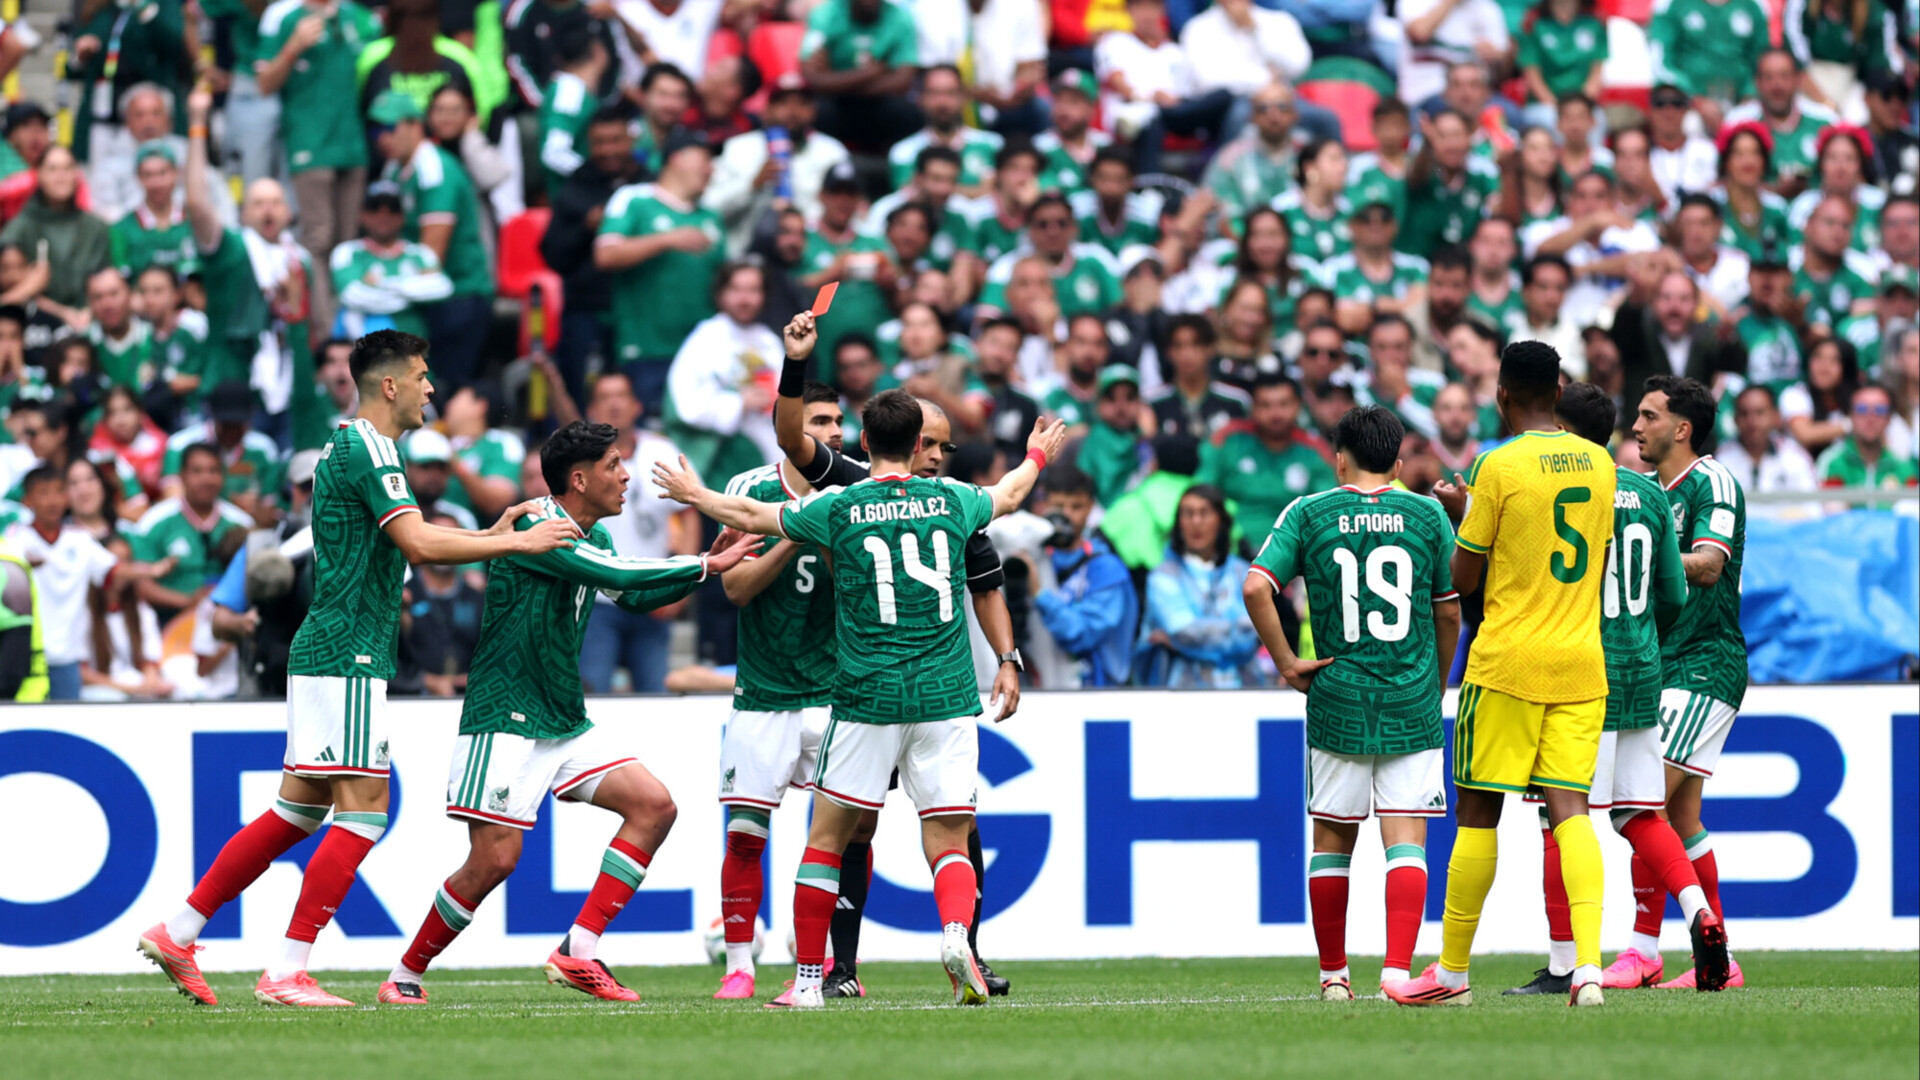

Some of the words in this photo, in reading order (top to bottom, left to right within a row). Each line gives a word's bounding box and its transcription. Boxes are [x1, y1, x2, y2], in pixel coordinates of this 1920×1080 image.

[1539, 452, 1593, 474] MBATHA
[849, 496, 950, 525] A.GONZÁLEZ
[1338, 513, 1405, 534] G.MORA
[1550, 486, 1591, 584] 5
[795, 555, 817, 594] 5
[863, 530, 953, 625] 14
[1333, 545, 1413, 643] 19
[1603, 522, 1653, 619] 10
